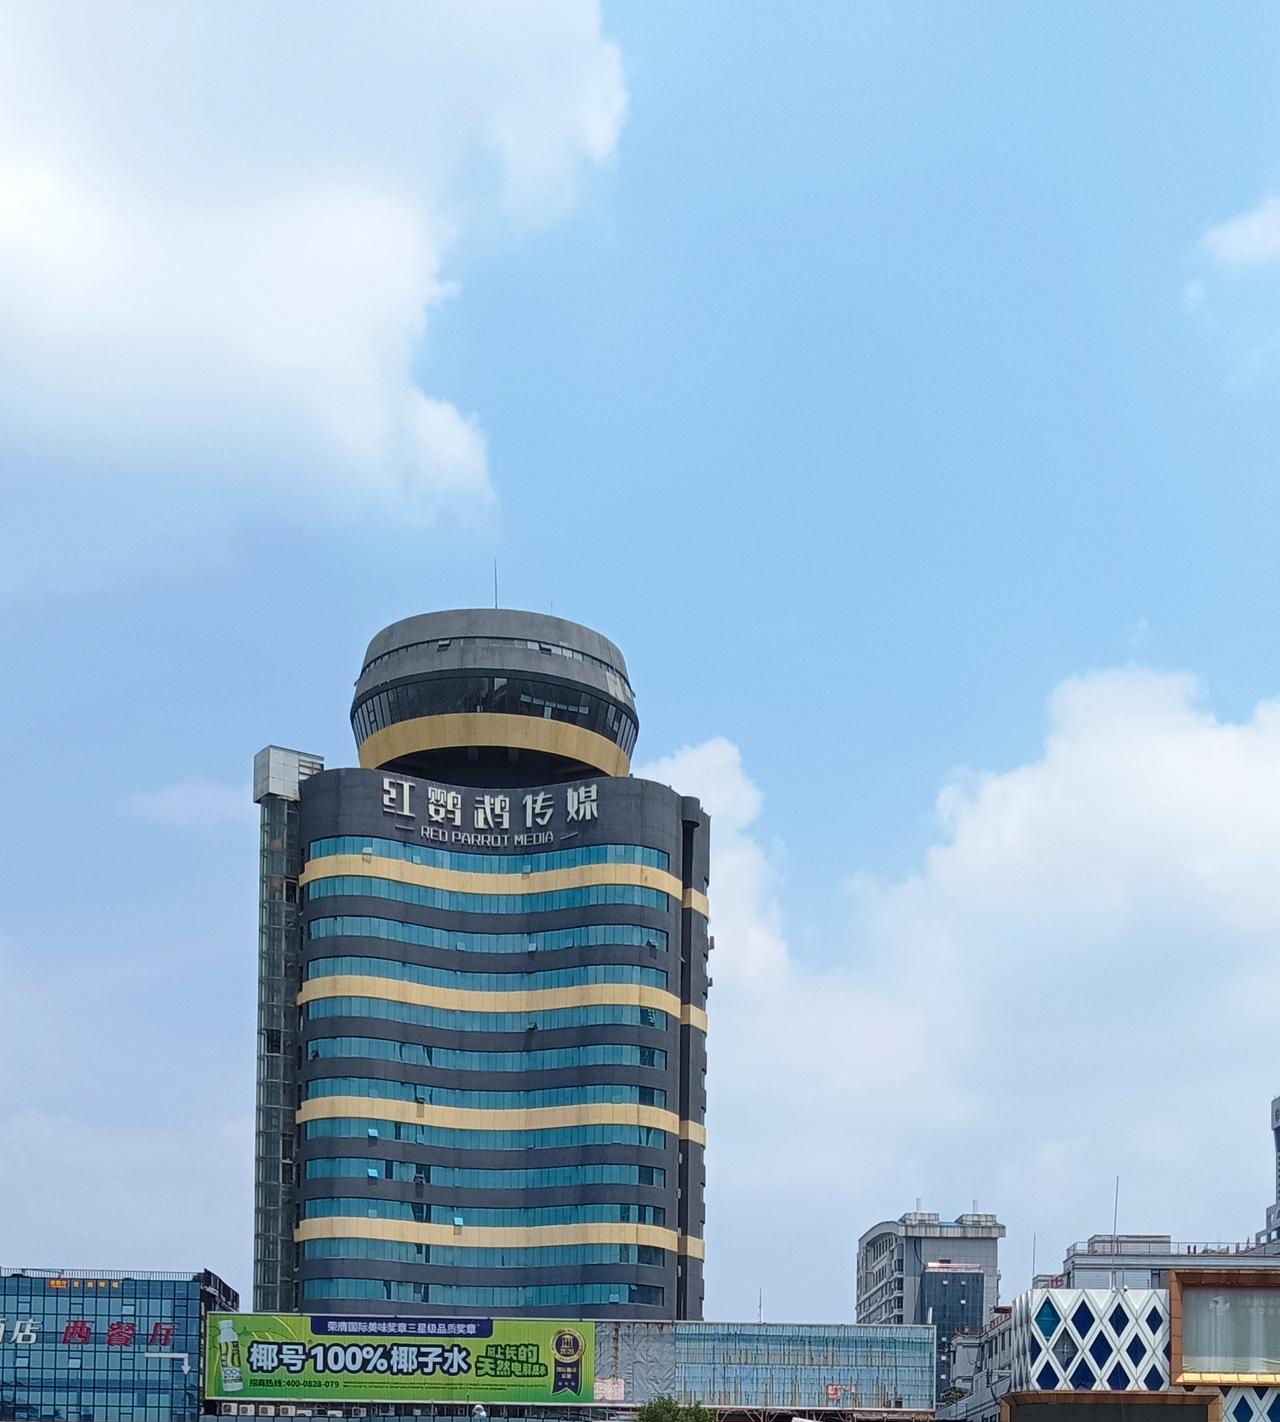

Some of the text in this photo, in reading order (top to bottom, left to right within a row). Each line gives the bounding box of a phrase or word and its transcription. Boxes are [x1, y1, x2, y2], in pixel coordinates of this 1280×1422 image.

[382, 777, 599, 830] 红鹦鹉传媒
[420, 825, 555, 848] RED PARROT MEDIA
[61, 1318, 180, 1347] 西餐厅
